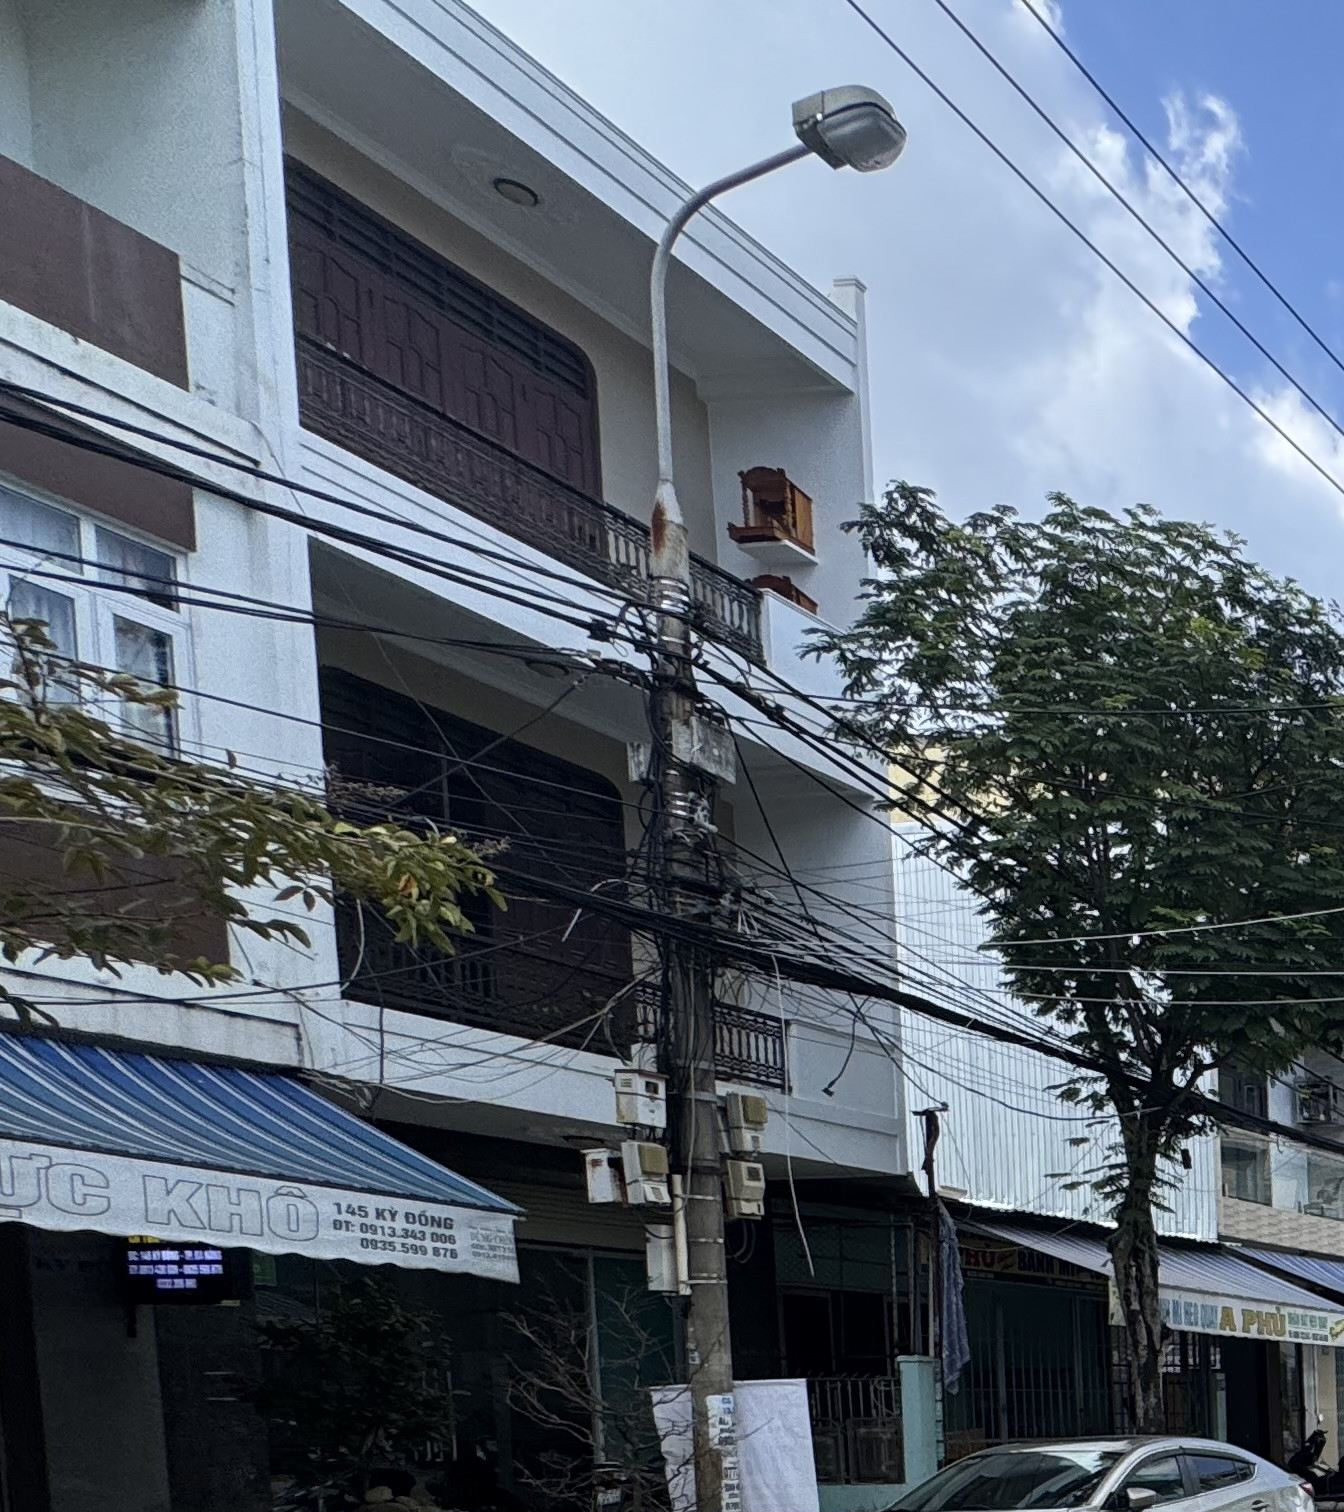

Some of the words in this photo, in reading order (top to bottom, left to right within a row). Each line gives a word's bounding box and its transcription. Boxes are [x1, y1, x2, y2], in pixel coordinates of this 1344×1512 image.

[141, 1174, 320, 1242] KHÔ
[333, 1202, 370, 1219] 145
[430, 1231, 458, 1246] 006
[1219, 1305, 1237, 1333] A
[1241, 1305, 1287, 1338] PHỦ
